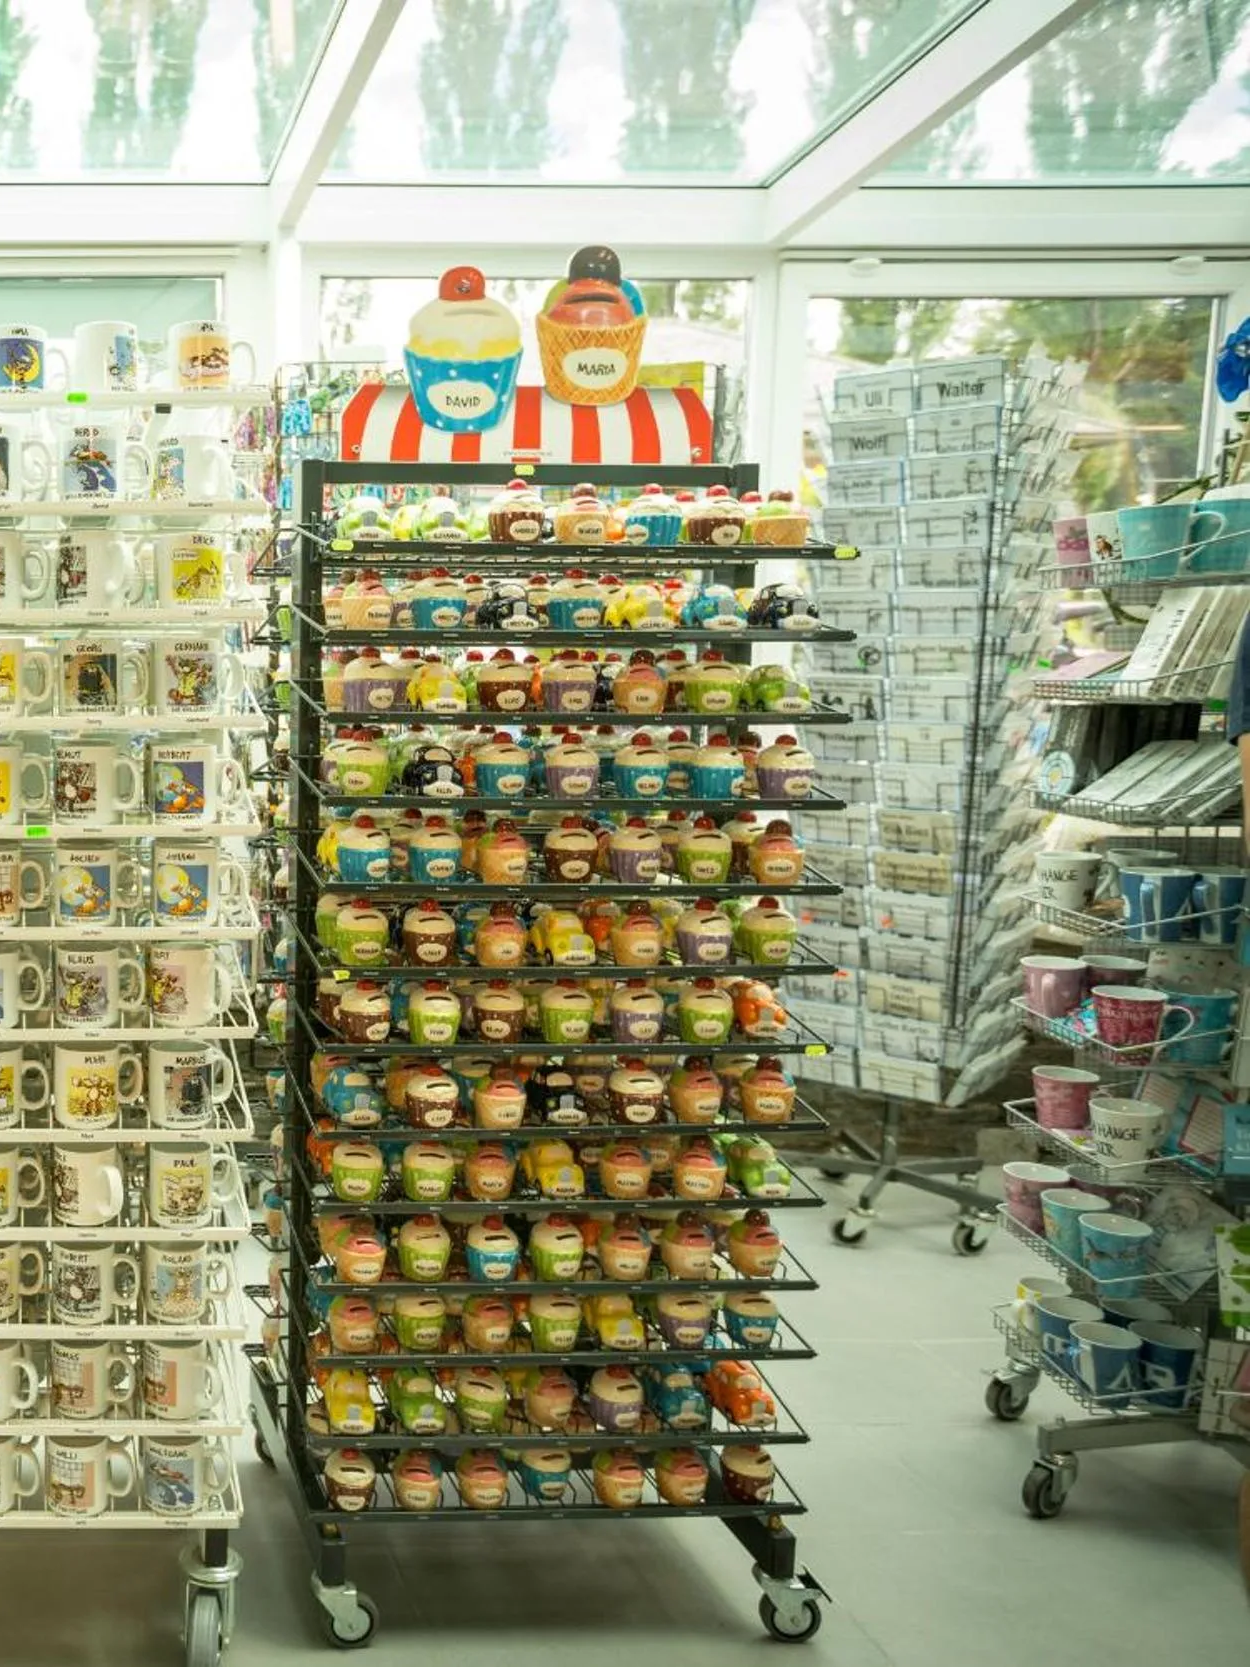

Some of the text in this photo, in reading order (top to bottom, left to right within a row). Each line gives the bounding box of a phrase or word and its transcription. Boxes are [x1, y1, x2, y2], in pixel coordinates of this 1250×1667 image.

[576, 362, 617, 377] MARIA
[936, 381, 985, 399] Walter
[445, 395, 481, 408] DAVID
